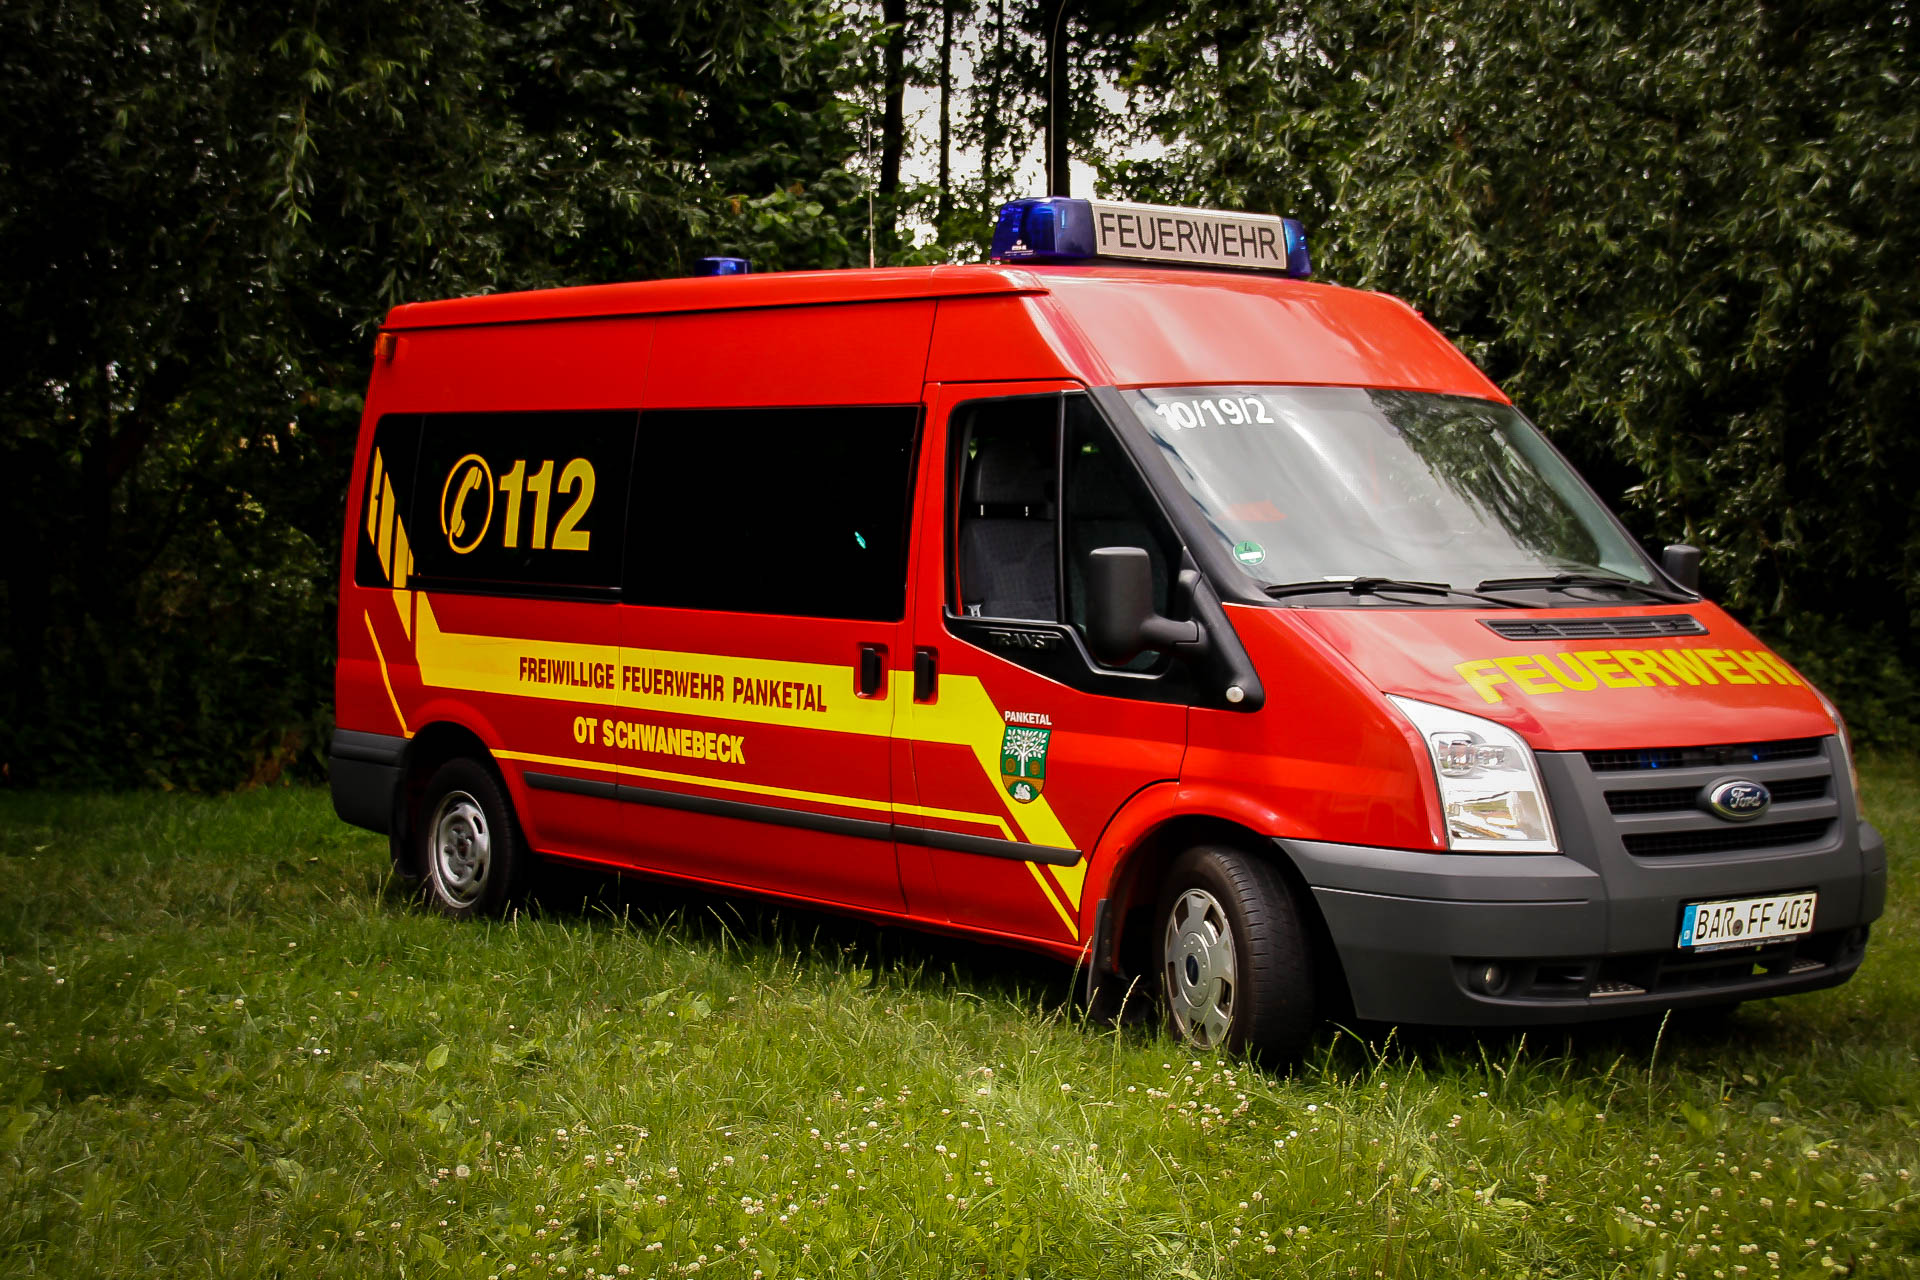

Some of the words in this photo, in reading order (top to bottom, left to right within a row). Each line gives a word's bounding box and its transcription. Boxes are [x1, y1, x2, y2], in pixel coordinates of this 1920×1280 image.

[1099, 212, 1278, 260] FEUERWEHR
[1155, 397, 1274, 431] 10/19/2
[499, 458, 596, 551] 112
[519, 656, 615, 690] FREIWILLIGE
[622, 665, 725, 702] FEUERWEHR
[733, 676, 828, 713] PANKETAL
[573, 716, 598, 745] OT
[602, 719, 746, 765] SCHWANEBECK
[1004, 710, 1052, 726] PANKETAL
[1730, 787, 1761, 809] Ford
[1695, 907, 1735, 940] BAR
[1747, 903, 1774, 935] FF
[1778, 898, 1813, 931] 403
